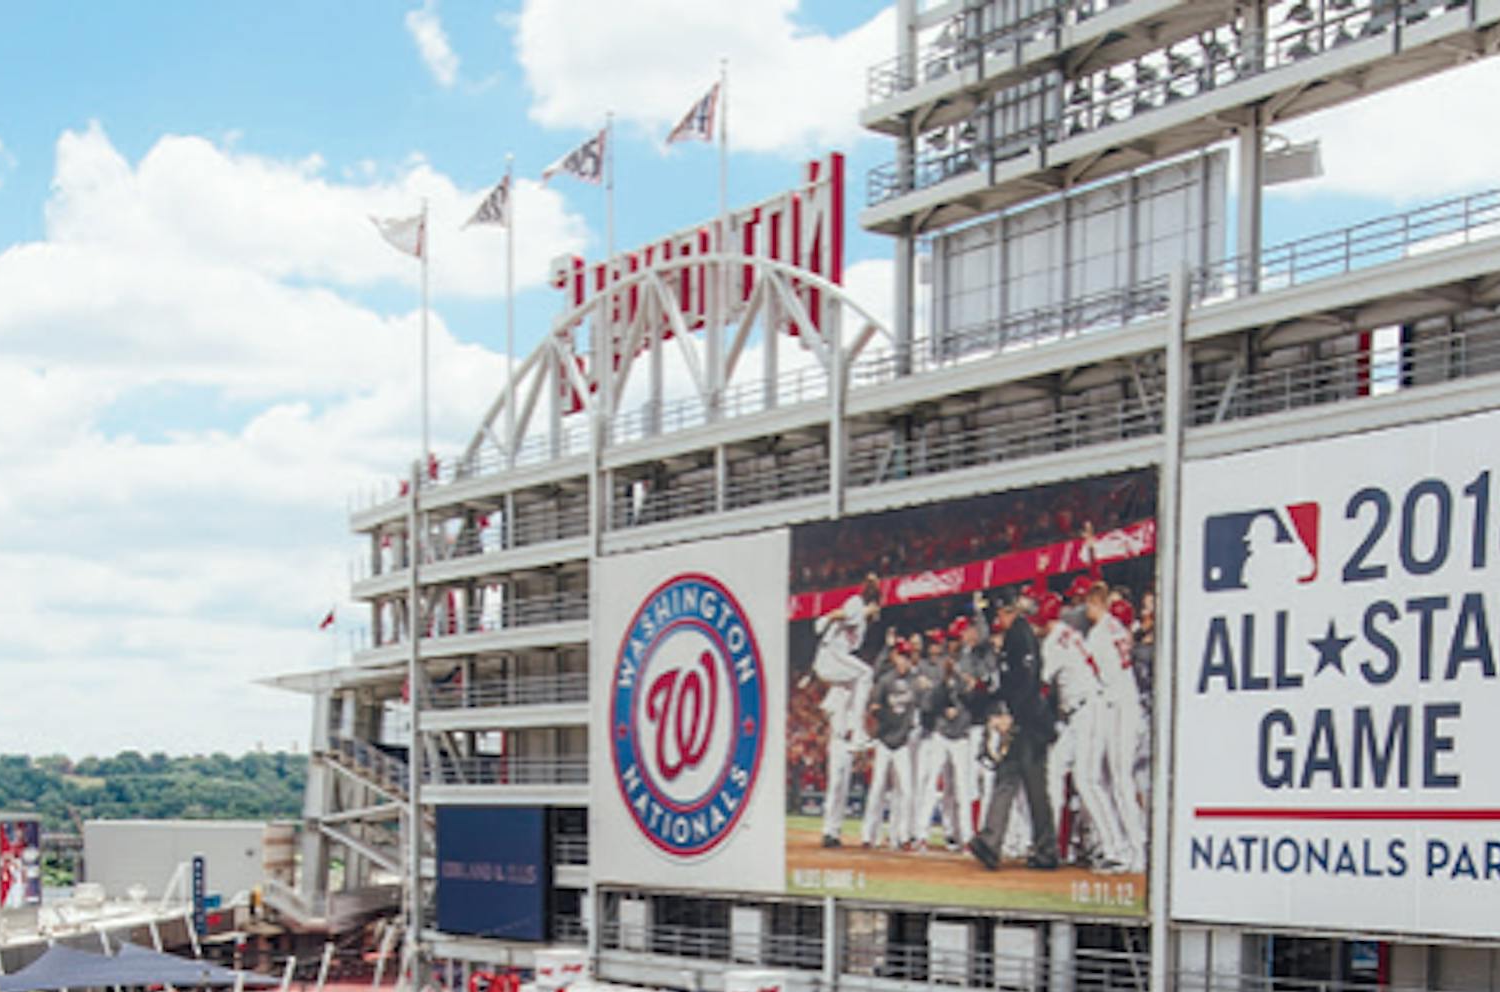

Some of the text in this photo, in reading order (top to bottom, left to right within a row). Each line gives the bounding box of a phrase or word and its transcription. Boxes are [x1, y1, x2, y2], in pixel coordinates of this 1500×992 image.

[618, 584, 756, 686] WASHINGTON
[644, 650, 719, 781] W
[1257, 703, 1463, 789] GAME
[621, 765, 750, 844] NATIONALS
[1070, 880, 1136, 907] 10.11.12
[1190, 836, 1408, 879] NATIONALS
